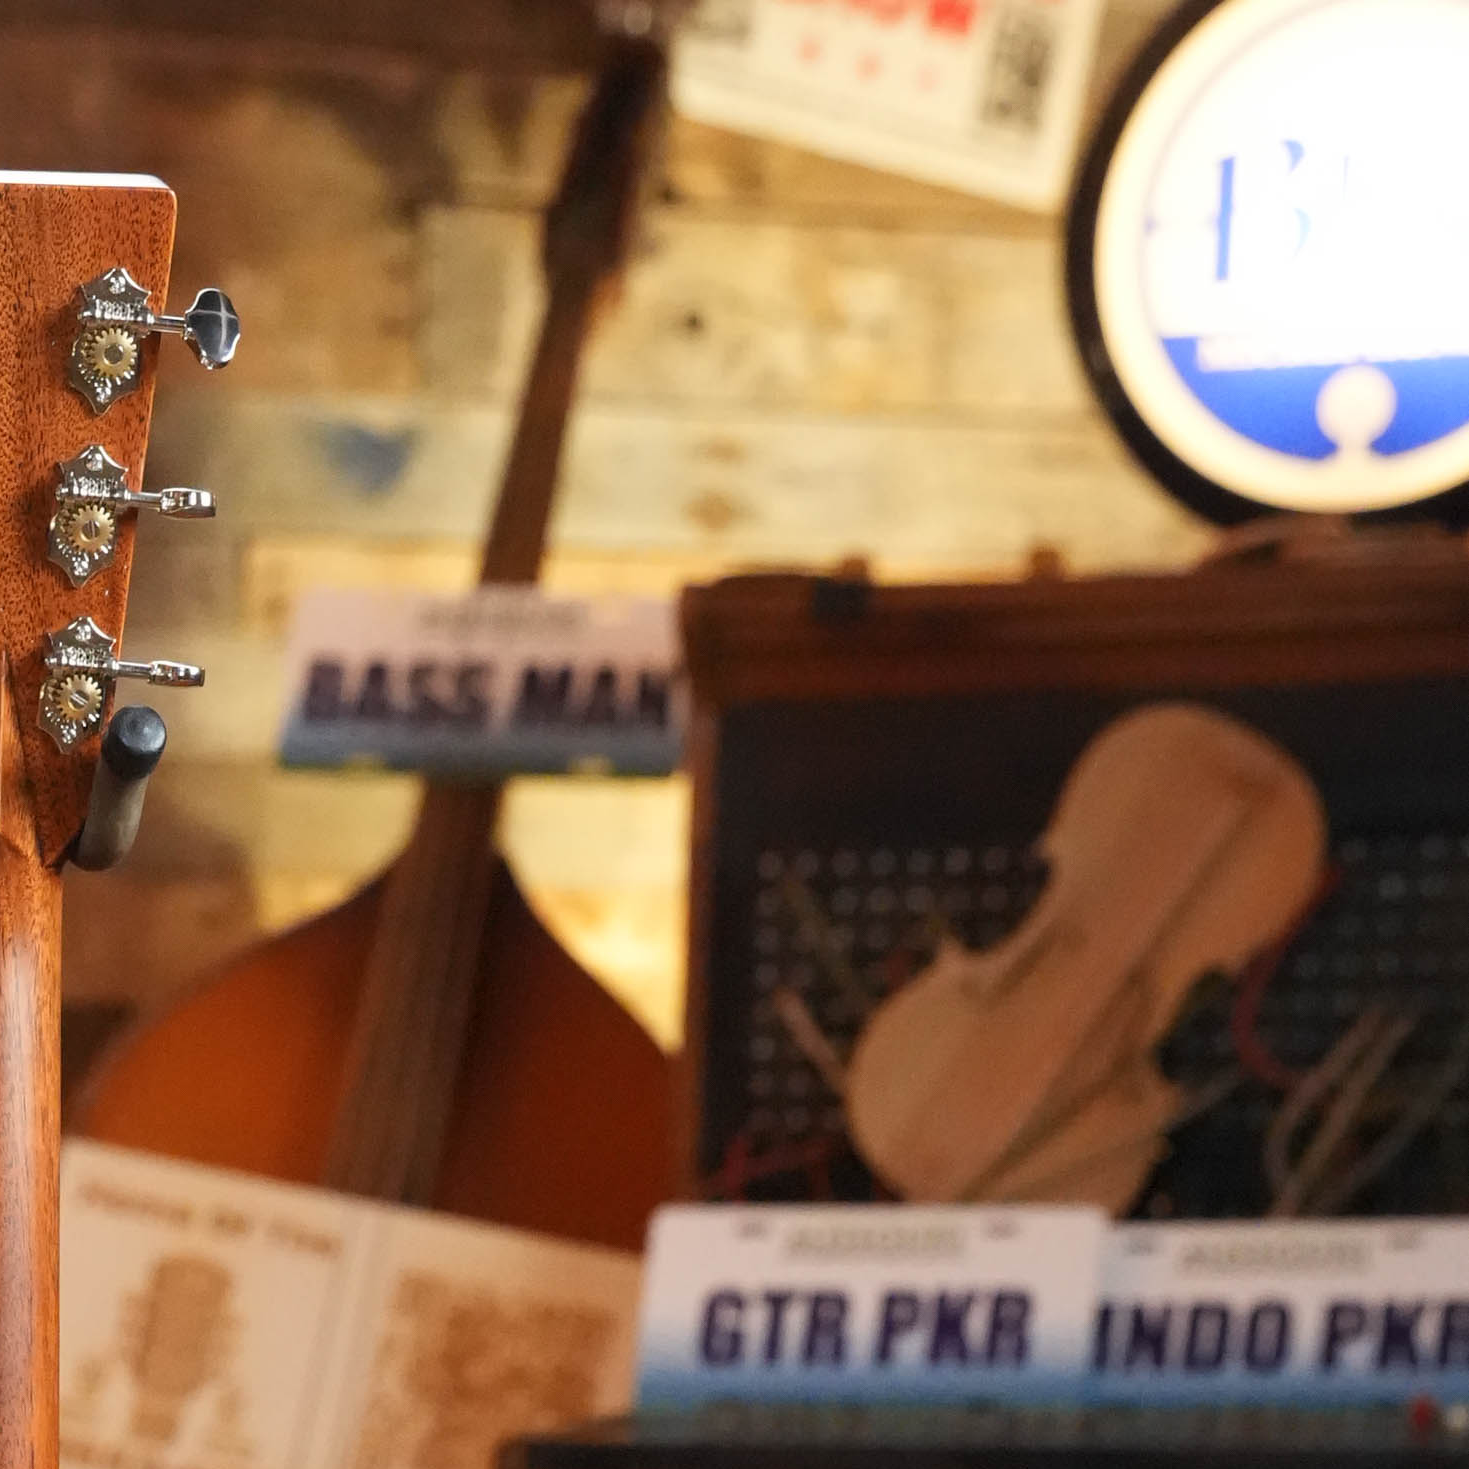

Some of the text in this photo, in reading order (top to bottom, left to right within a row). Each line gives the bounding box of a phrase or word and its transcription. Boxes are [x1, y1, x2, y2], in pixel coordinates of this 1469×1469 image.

[304, 658, 674, 728] BASS MAN
[702, 1288, 1032, 1370] GTR PKR
[1092, 1303, 1469, 1371] INDO PKR
